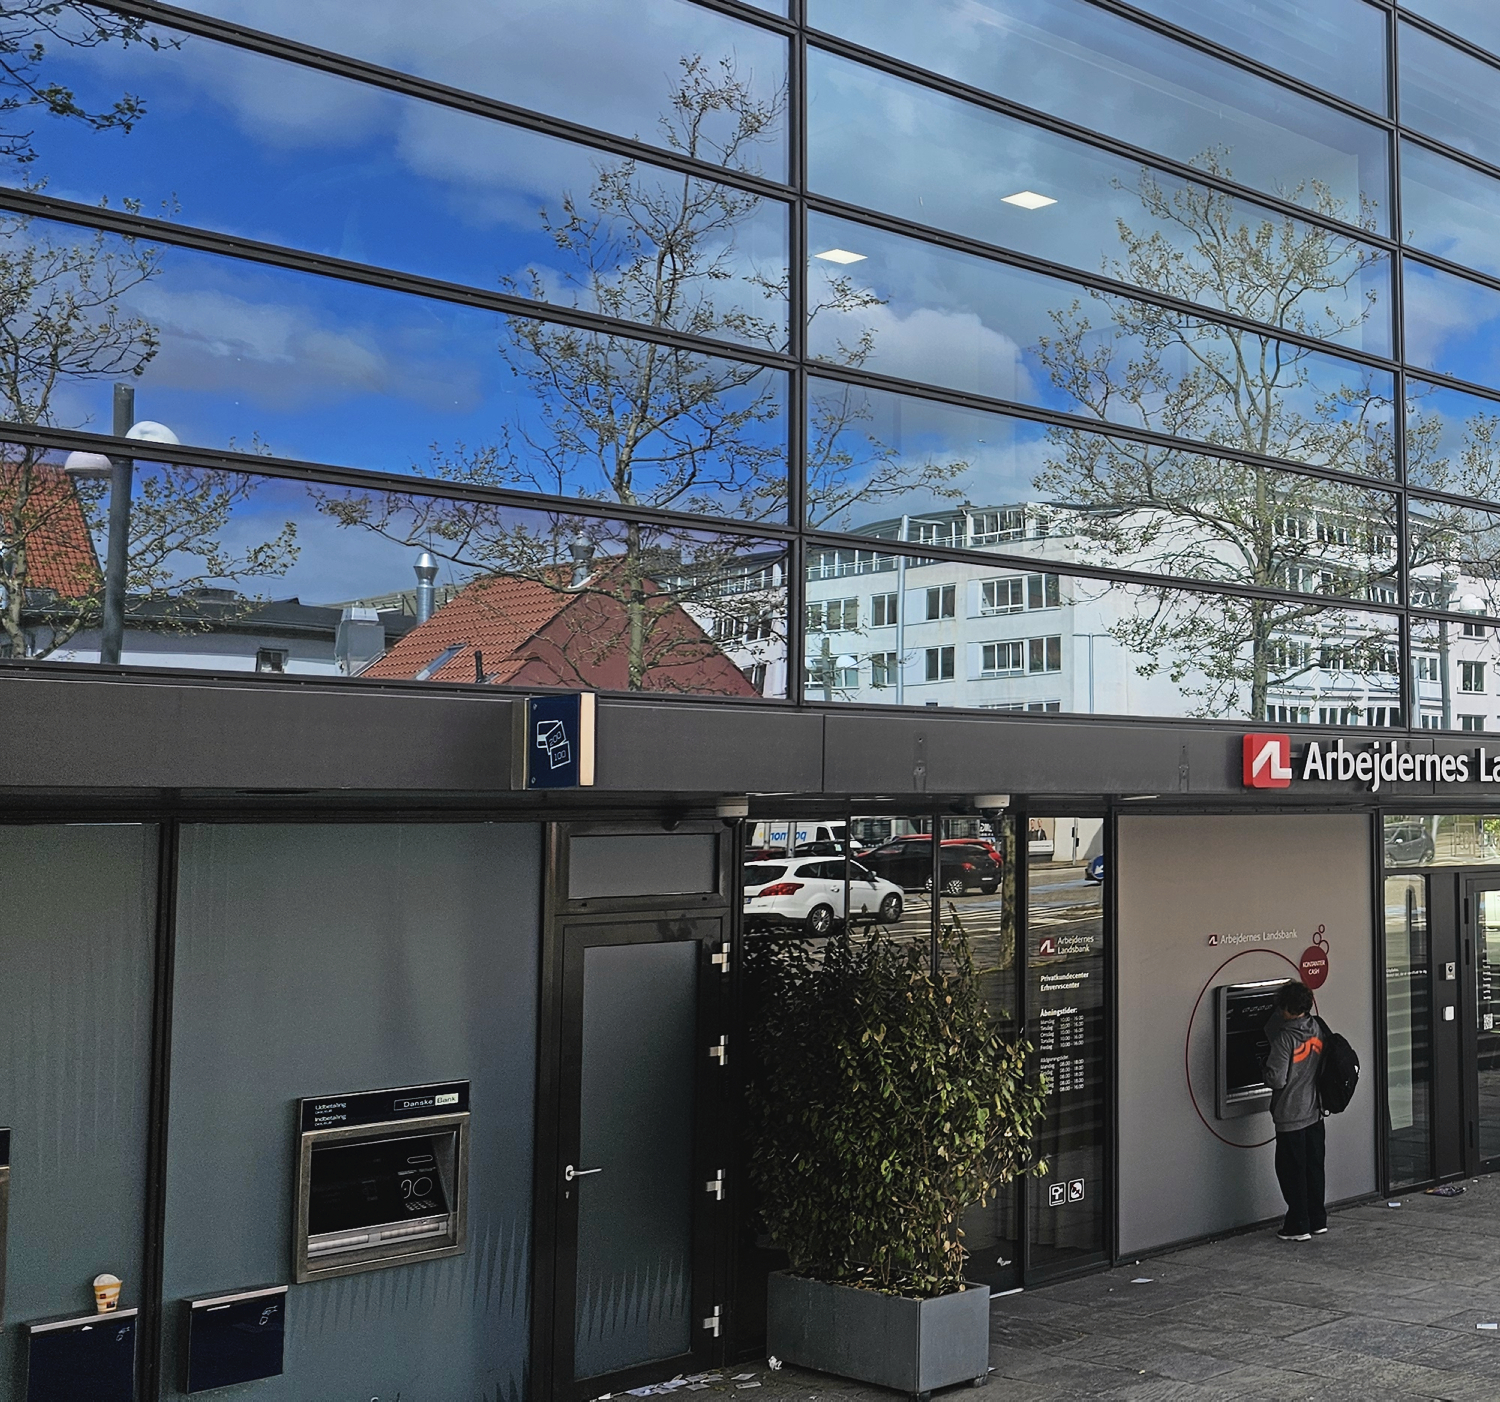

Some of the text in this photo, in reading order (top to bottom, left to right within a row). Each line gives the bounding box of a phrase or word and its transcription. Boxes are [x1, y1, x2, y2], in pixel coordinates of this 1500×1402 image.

[1302, 739, 1469, 792] Arbejdernes
[1058, 936, 1094, 947] Arbejdernes
[1220, 933, 1260, 945] Arbejdernes
[1263, 929, 1298, 941] Landsbank
[1058, 944, 1090, 955] Landsbank
[404, 1096, 456, 1108] Danske Bank
